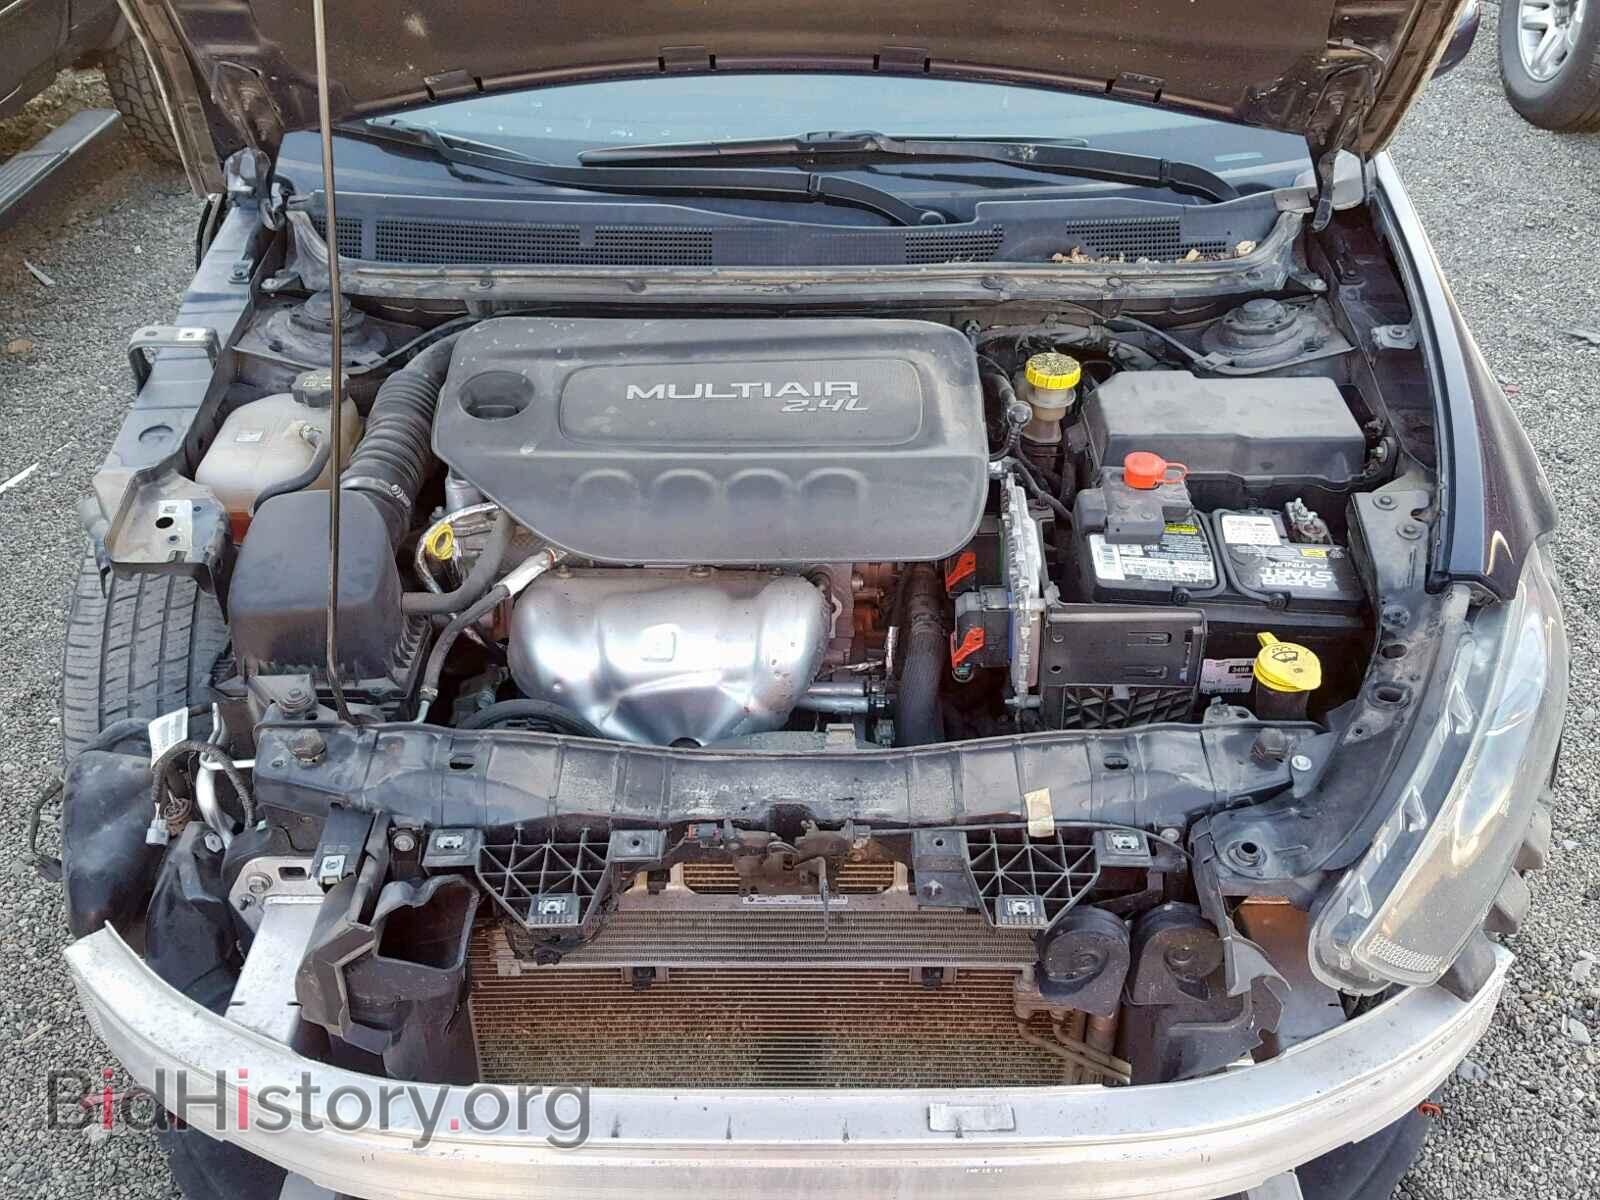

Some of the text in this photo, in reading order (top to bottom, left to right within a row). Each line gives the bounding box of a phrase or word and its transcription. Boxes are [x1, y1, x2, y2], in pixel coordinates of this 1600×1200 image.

[626, 381, 858, 399] MULTIAIR
[781, 399, 868, 412] 2.4L
[1263, 567, 1333, 580] START
[1262, 576, 1327, 588] SUPER
